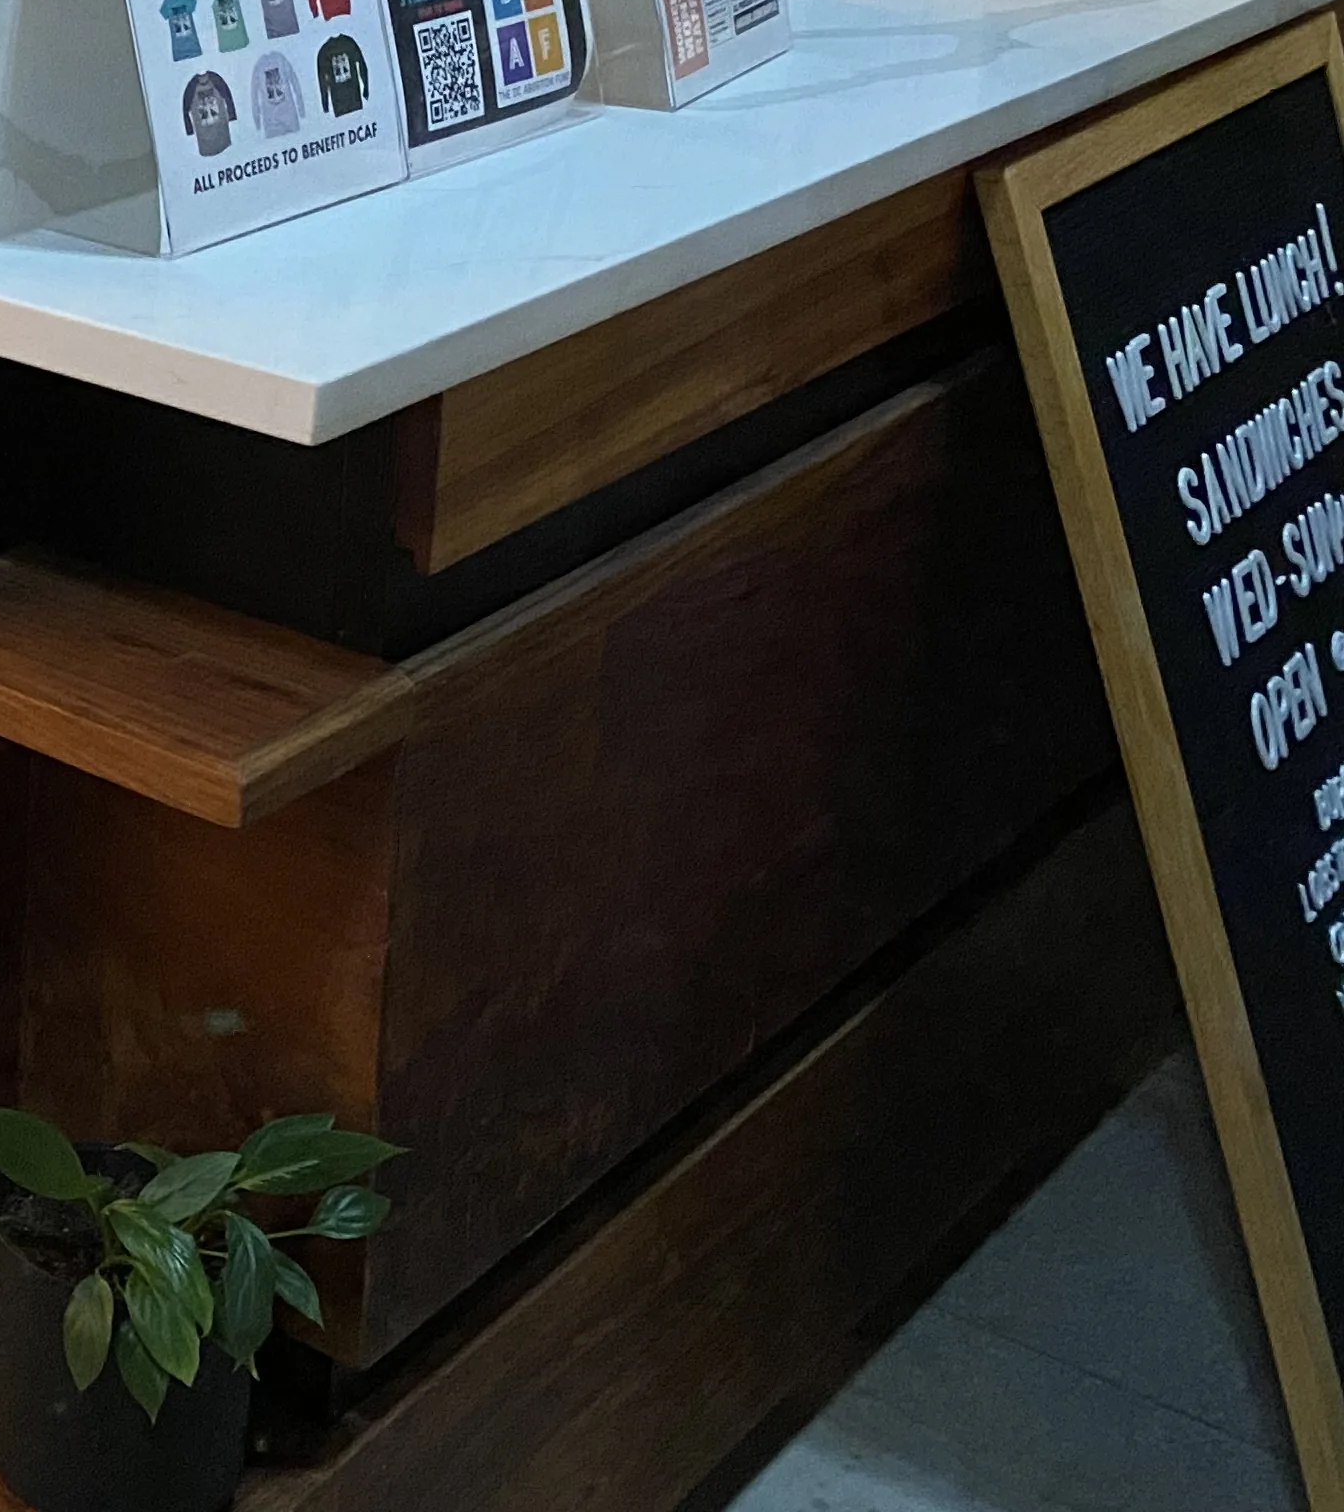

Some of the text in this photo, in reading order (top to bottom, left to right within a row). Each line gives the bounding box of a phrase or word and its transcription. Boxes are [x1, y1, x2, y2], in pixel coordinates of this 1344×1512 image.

[509, 28, 552, 70] A F
[193, 122, 378, 194] ALL PROCEEDS TO BENEFIT DCAF
[1106, 202, 1344, 433] WE HAVE LUNCH!
[1177, 360, 1344, 546] SANDWICHES
[1251, 641, 1328, 772] OPEN
